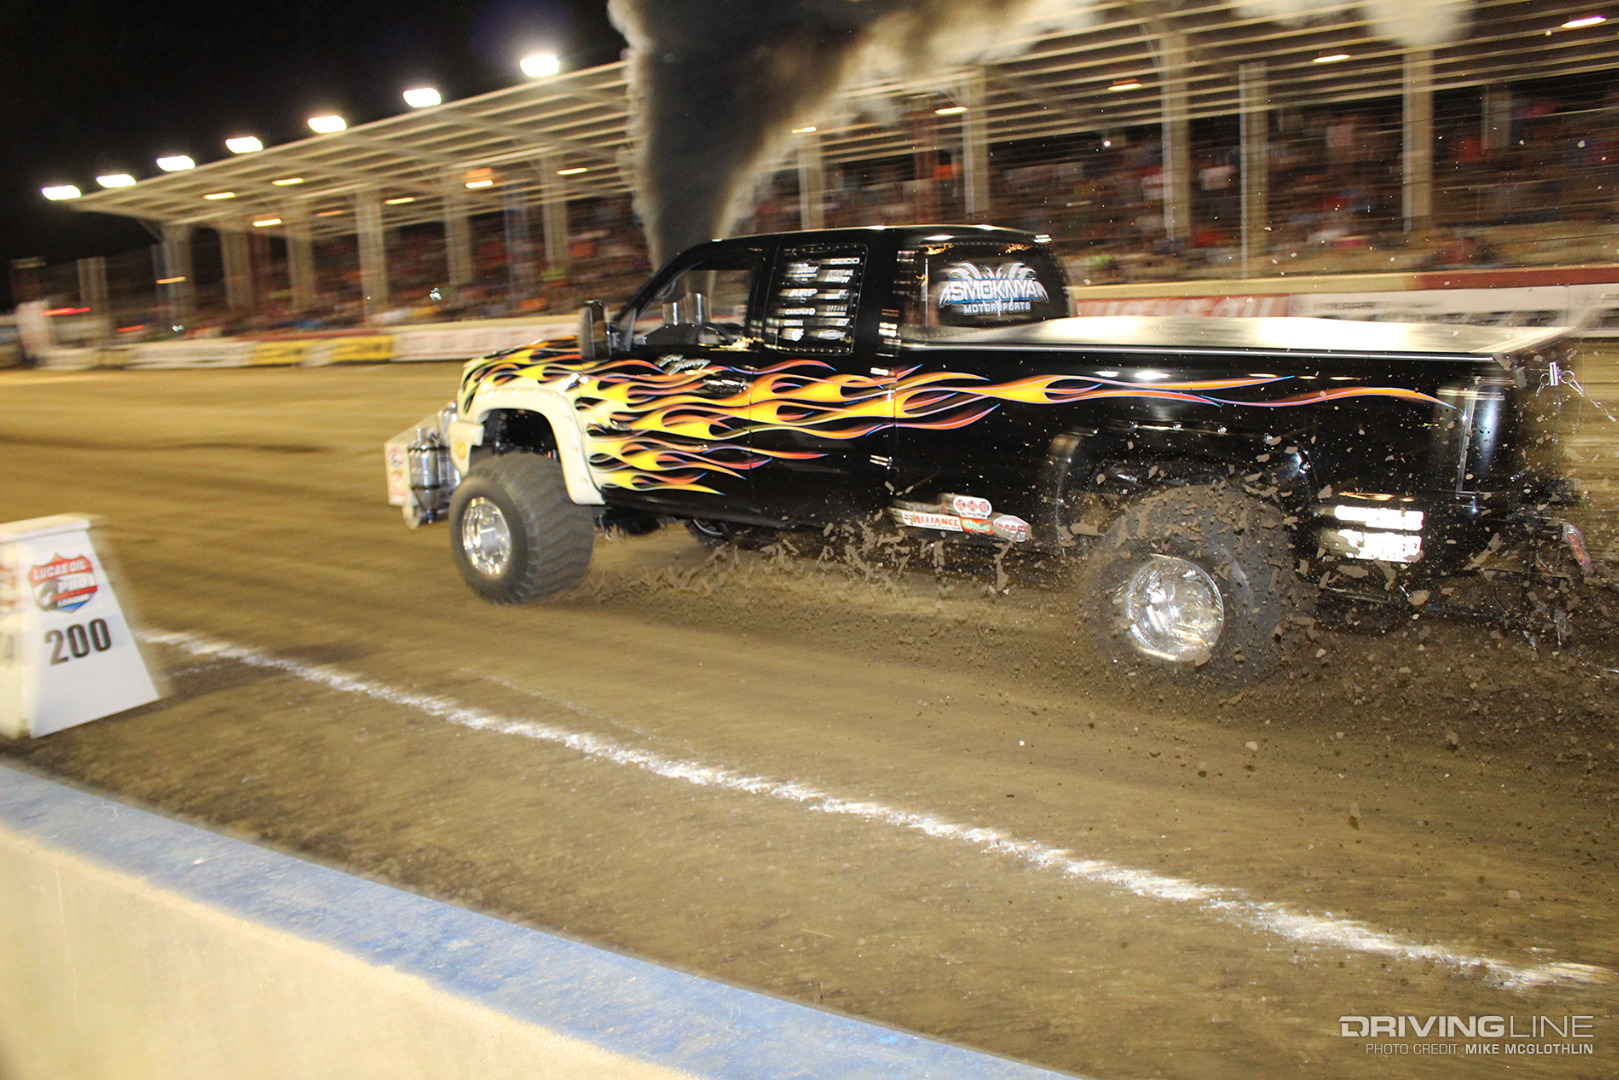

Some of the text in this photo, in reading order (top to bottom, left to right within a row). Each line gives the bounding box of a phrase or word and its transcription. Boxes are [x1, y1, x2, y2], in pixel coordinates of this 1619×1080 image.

[788, 288, 818, 297] ARP
[963, 301, 1031, 315] MOTORSPORTS
[914, 515, 960, 527] ALLIANCE
[33, 559, 87, 581] LUCAS OIL
[44, 617, 113, 667] 200
